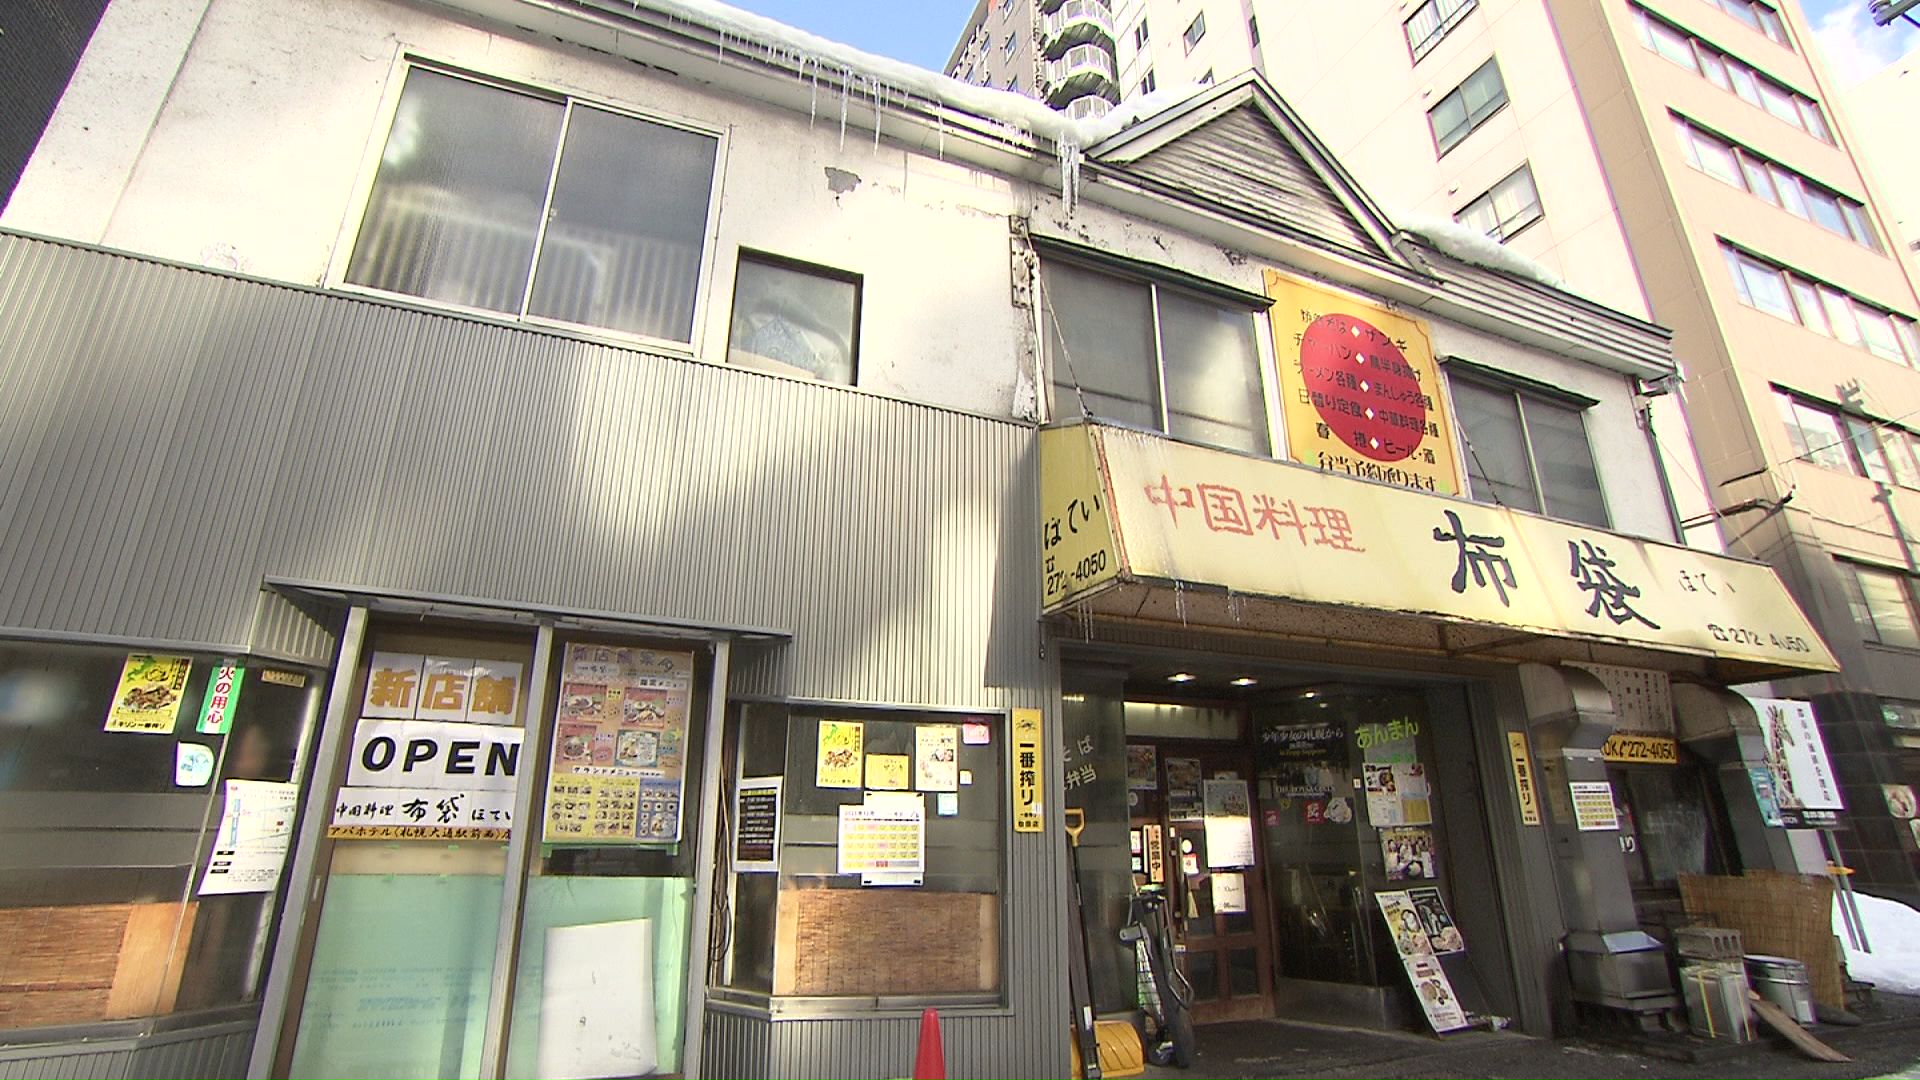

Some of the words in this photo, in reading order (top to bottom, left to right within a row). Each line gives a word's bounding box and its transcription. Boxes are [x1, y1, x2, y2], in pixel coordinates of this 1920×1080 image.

[1044, 494, 1101, 551] ほてい
[1143, 474, 1367, 553] 中国料理
[207, 665, 236, 725] 火の用心
[370, 667, 517, 715] 新店舗
[361, 736, 521, 777] OPEN
[1354, 716, 1419, 749] あんまん
[1019, 742, 1036, 806] 一番搾り
